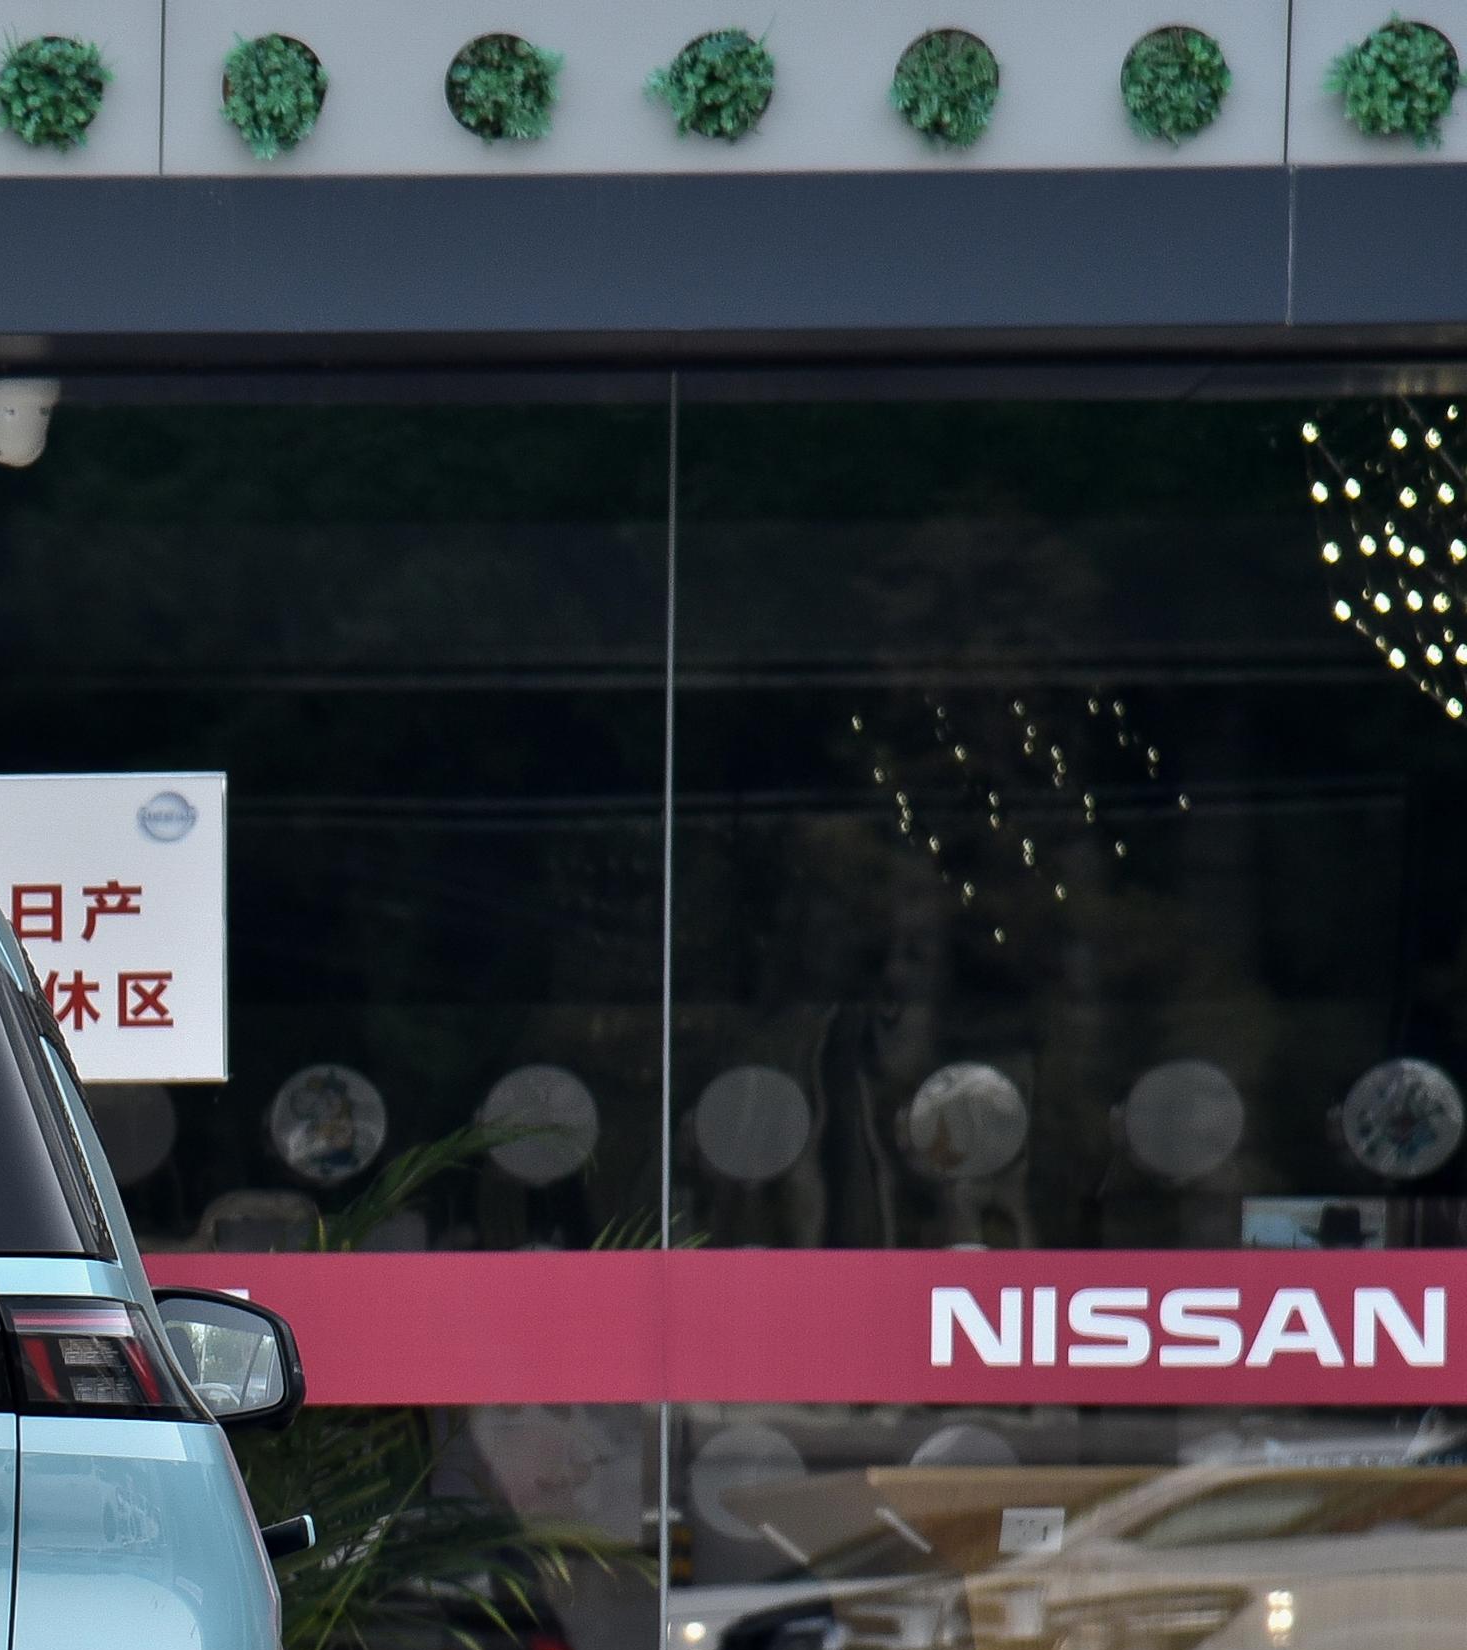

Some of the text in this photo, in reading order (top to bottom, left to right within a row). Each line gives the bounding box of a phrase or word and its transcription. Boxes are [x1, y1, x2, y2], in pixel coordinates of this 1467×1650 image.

[12, 880, 142, 942] 日产
[43, 970, 173, 1031] 休区
[931, 1287, 1446, 1367] NISSAN
